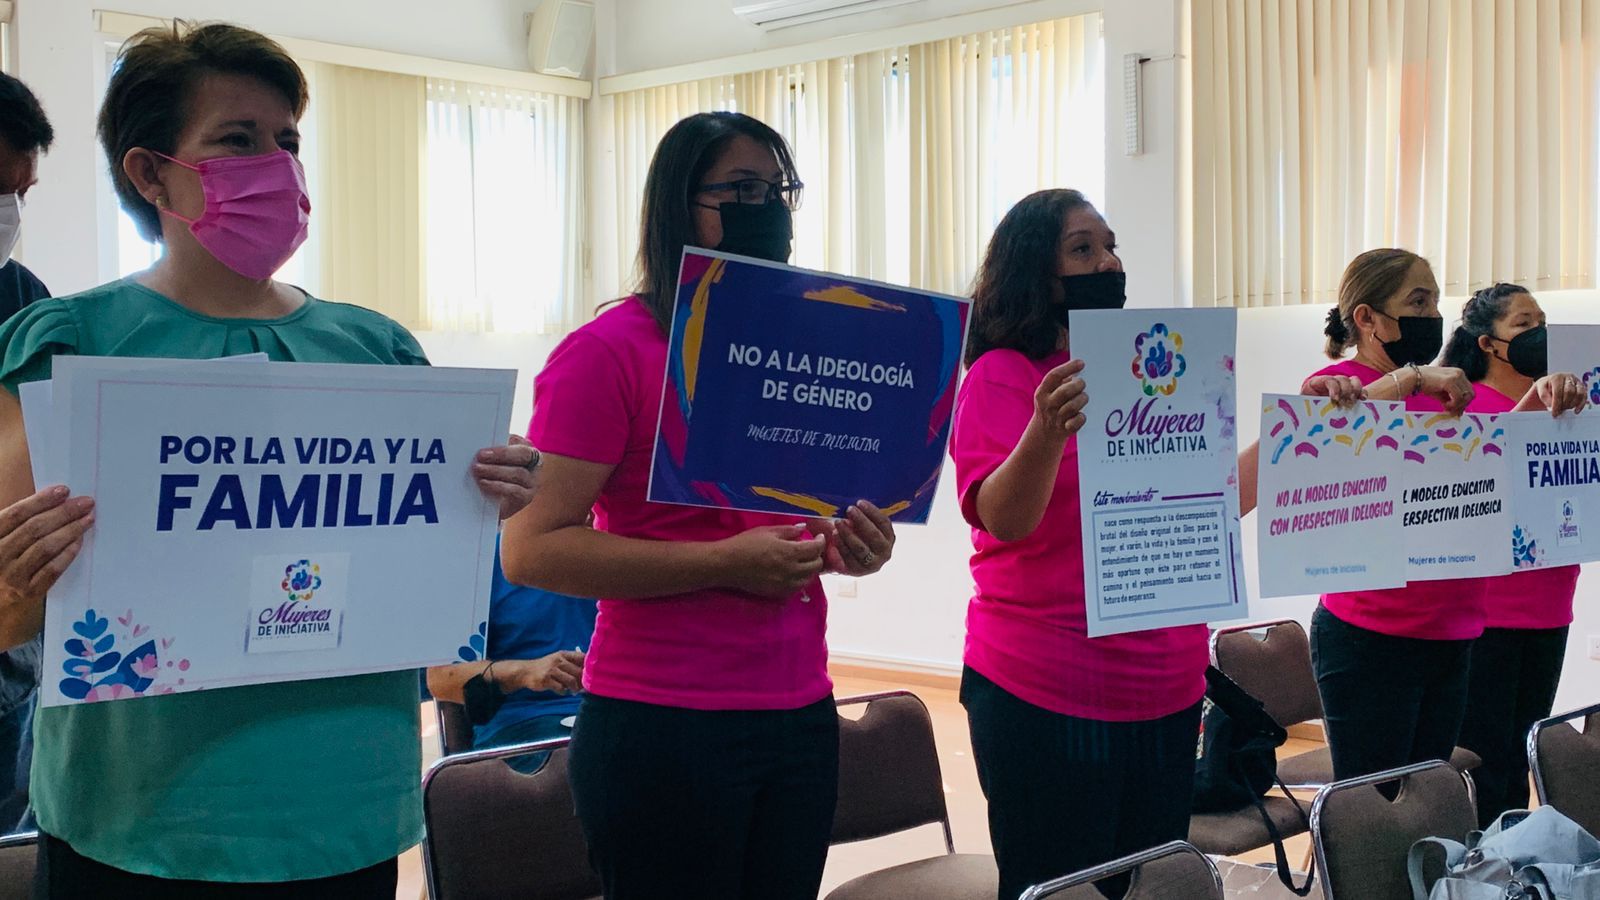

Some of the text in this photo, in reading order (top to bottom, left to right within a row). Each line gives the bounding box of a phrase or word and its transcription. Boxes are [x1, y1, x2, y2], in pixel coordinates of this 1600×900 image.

[728, 343, 914, 389] NO A LA IDEOLOGÍA
[762, 379, 872, 412] DE GÉNERO
[1105, 397, 1206, 442] Mujeres
[160, 435, 446, 465] POR LA VIDA Y LA
[1107, 435, 1207, 457] DE INICIATIVA
[1526, 439, 1600, 456] POR LA VIDA Y LA
[1528, 457, 1600, 488] FAMILIA
[156, 472, 440, 532] FAMILIA
[1276, 475, 1388, 508] NO AL MODELO EDUCATIVO
[1403, 478, 1495, 504] L MODELO EDUCATIVO
[1118, 518, 1133, 526] como
[1134, 515, 1161, 525] respuesta
[1270, 500, 1394, 537] CON PERSPECTIVA IDELOGICA
[1403, 499, 1502, 527] ERSPECTIVA IDELOGICA
[1100, 531, 1116, 541] brutal
[1119, 530, 1128, 539] del
[1151, 525, 1171, 537] original
[1183, 524, 1195, 533] Dios
[1197, 524, 1210, 533] para
[1212, 522, 1218, 530] la
[1119, 543, 1125, 551] el
[1144, 540, 1150, 548] la
[1151, 540, 1163, 548] vida
[1170, 538, 1175, 546] la
[1213, 534, 1219, 542] el
[1117, 567, 1141, 578] oportuno
[1144, 567, 1154, 576] que
[1173, 563, 1186, 573] para
[1215, 559, 1220, 567] el
[1141, 554, 1148, 562] de
[1151, 553, 1161, 563] que
[1172, 550, 1183, 560] hay
[1408, 556, 1437, 566] Mujeres
[1438, 555, 1447, 564] de
[1103, 583, 1122, 592] camino
[1132, 580, 1138, 588] el
[1140, 576, 1174, 589] pensamiento
[1177, 574, 1193, 584] social
[1196, 573, 1211, 581] hacia
[1103, 596, 1121, 605] futuro
[1121, 594, 1128, 603] de
[258, 600, 332, 629] Mujeres
[257, 622, 330, 636] DE INICIATIVA
